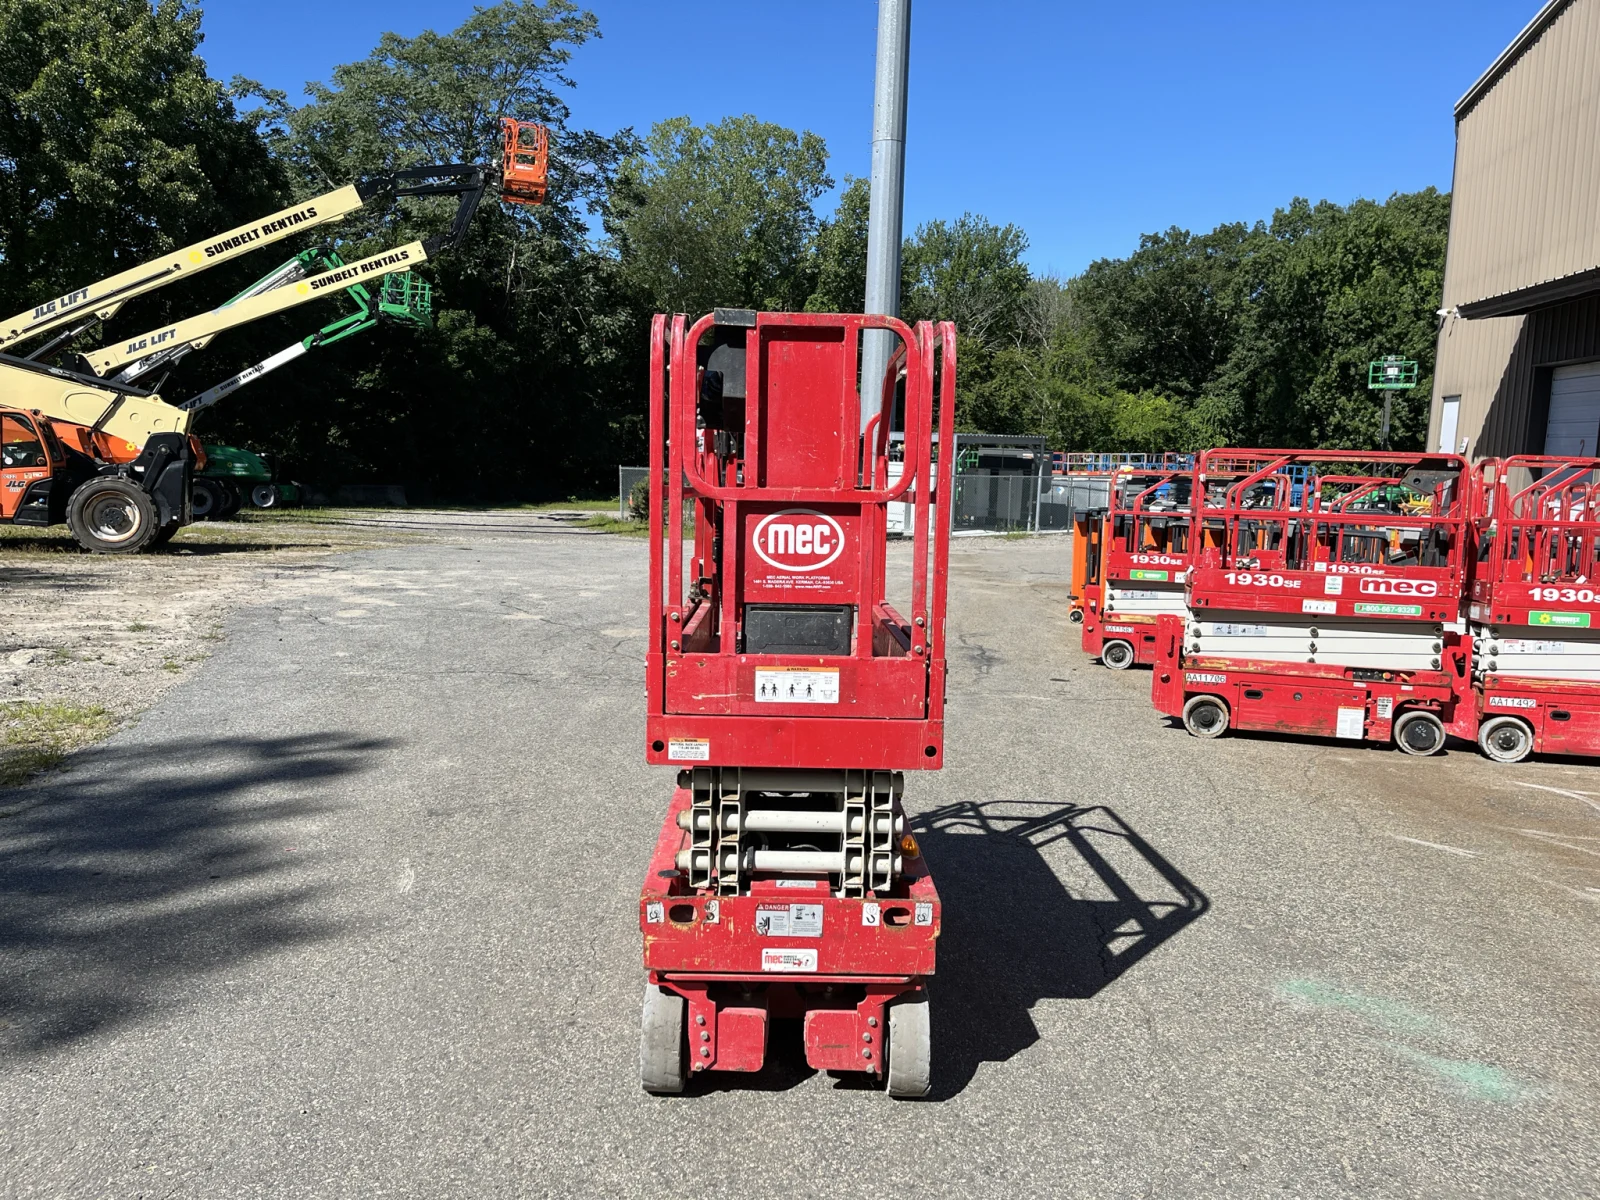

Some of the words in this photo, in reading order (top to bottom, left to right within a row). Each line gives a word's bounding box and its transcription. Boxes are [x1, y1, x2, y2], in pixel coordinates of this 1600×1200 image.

[205, 228, 259, 257] SUNBELT
[262, 207, 317, 235] RENTALS
[310, 266, 358, 290] SUNBELT
[362, 250, 409, 273] RENTALS
[32, 301, 56, 320] JLG
[60, 288, 88, 308] LIFT
[126, 339, 146, 354] JLG
[151, 329, 176, 344] LIFT
[220, 376, 242, 391] SUNBELT
[768, 524, 830, 554] mec
[1130, 554, 1182, 565] 1930SE
[1224, 573, 1301, 588] 1930SE
[1361, 578, 1436, 595] mec
[1187, 674, 1226, 682] AA11706
[1490, 698, 1535, 707] AA11492
[765, 955, 783, 964] mec
